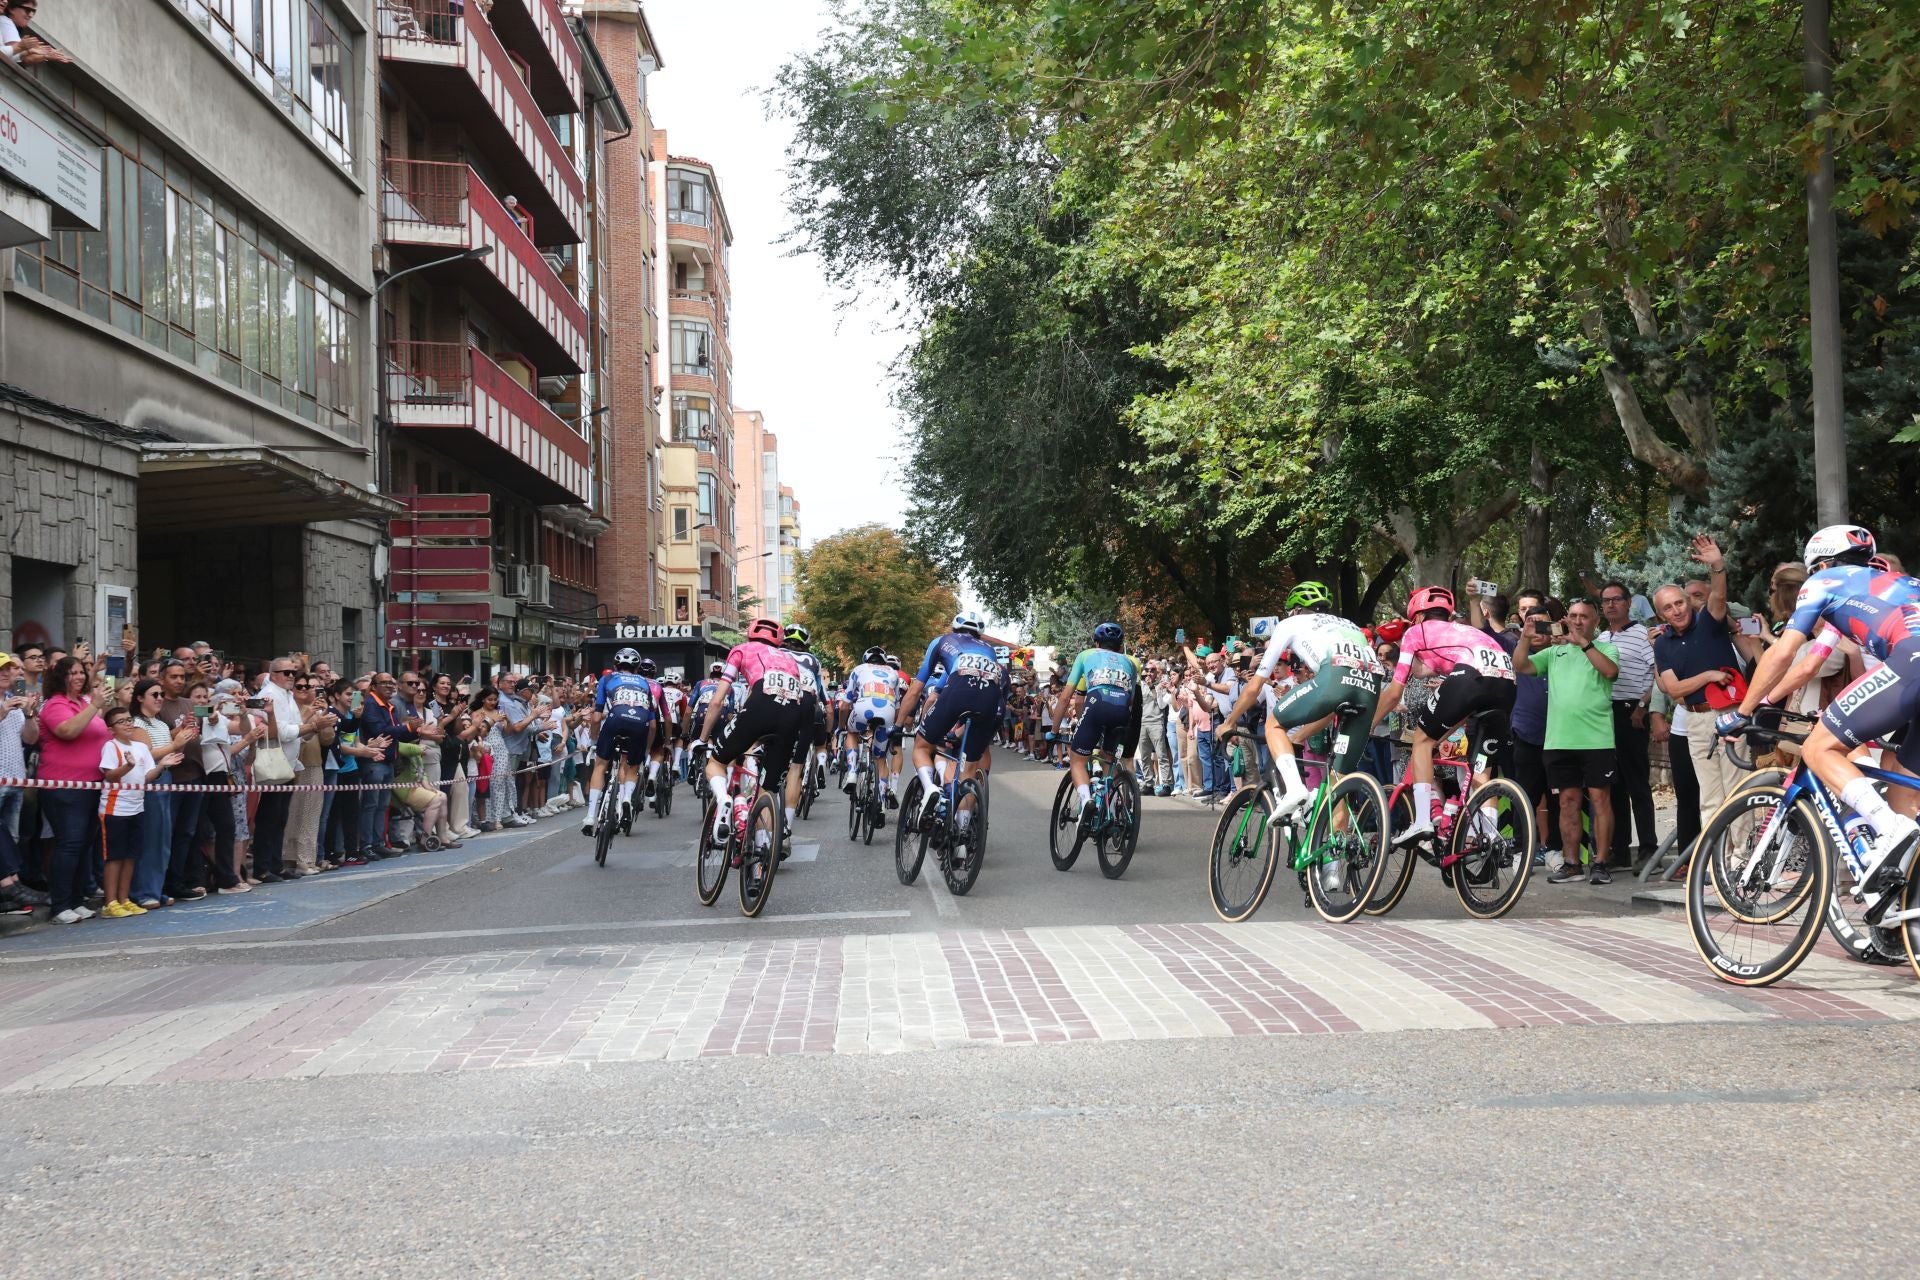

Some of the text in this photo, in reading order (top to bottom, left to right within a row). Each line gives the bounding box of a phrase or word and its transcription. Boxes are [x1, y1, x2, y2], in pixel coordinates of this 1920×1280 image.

[1, 110, 17, 144] cto
[1846, 599, 1879, 615] QUICK-STEP
[615, 622, 693, 639] terraza
[1335, 642, 1361, 659] 145
[1480, 649, 1498, 668] 82
[960, 655, 981, 670] 223
[1503, 655, 1512, 670] 8
[768, 673, 784, 688] 85
[1349, 668, 1374, 682] CAJA
[1341, 676, 1377, 694] RURAL
[1840, 670, 1896, 712] SOUDAL
[1747, 795, 1783, 807] rov
[1812, 791, 1865, 882] S-WORKS
[1712, 955, 1762, 975] roval
